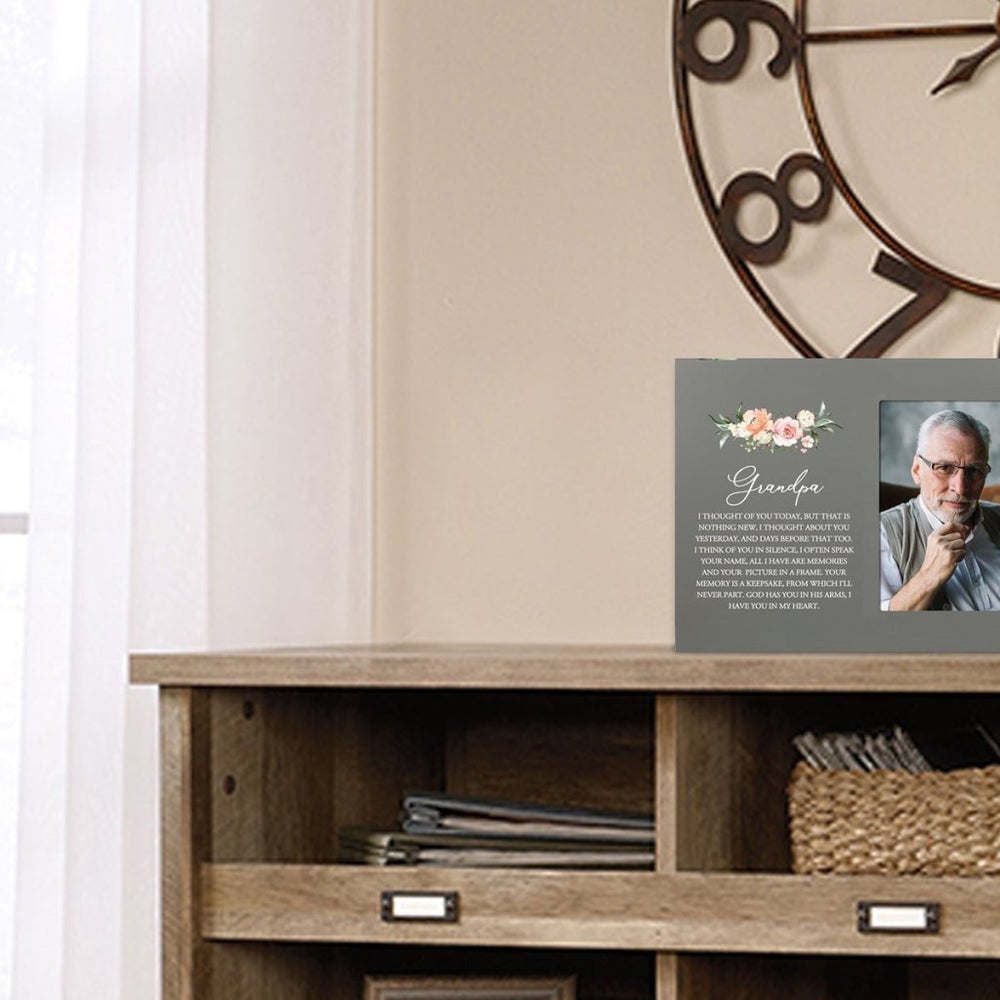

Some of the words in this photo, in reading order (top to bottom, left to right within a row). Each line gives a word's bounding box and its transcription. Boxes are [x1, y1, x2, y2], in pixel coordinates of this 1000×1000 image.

[719, 152, 834, 267] 8
[845, 249, 951, 358] 7
[725, 465, 825, 507] Grandpa
[702, 512, 743, 520] THOUGHT
[744, 512, 756, 520] OF
[756, 512, 773, 520] YOU
[804, 512, 820, 520] BUT
[822, 512, 843, 520] THAT
[844, 512, 851, 520] IS
[698, 523, 737, 532] NOTHING
[763, 523, 804, 532] THOUGHT
[805, 523, 832, 532] ABOUT
[833, 523, 850, 532] YOU
[741, 534, 758, 543] AND
[760, 534, 779, 543] DAYS
[780, 534, 810, 543] BEFORE
[810, 534, 832, 543] THAT
[698, 546, 724, 554] THINK
[725, 546, 736, 554] OF
[737, 546, 754, 554] YOU
[755, 546, 764, 554] IN
[803, 546, 830, 554] OFTEN
[831, 546, 854, 554] SPEAK
[701, 557, 723, 565] YOUR
[749, 557, 763, 565] ALL
[769, 557, 790, 565] HAVE
[791, 557, 806, 565] ARE
[807, 557, 848, 565] MEMORIES
[702, 568, 720, 576] AND
[721, 568, 742, 576] YOUR
[745, 568, 778, 576] PICTURE
[779, 568, 788, 576] IN
[789, 568, 796, 576] A
[824, 568, 846, 576] YOUR
[696, 580, 731, 588] MEMORY
[731, 580, 738, 588] IS
[739, 580, 746, 588] A
[786, 580, 809, 588] FROM
[810, 580, 838, 588] WHICH
[697, 591, 722, 599] NEVER
[746, 591, 765, 599] GOD
[766, 591, 781, 599] HAS
[782, 591, 798, 599] YOU
[799, 591, 809, 599] IN
[810, 591, 824, 599] HIS
[728, 602, 750, 610] HAVE
[750, 602, 768, 610] YOU
[768, 602, 778, 610] IN
[779, 602, 792, 610] MY
